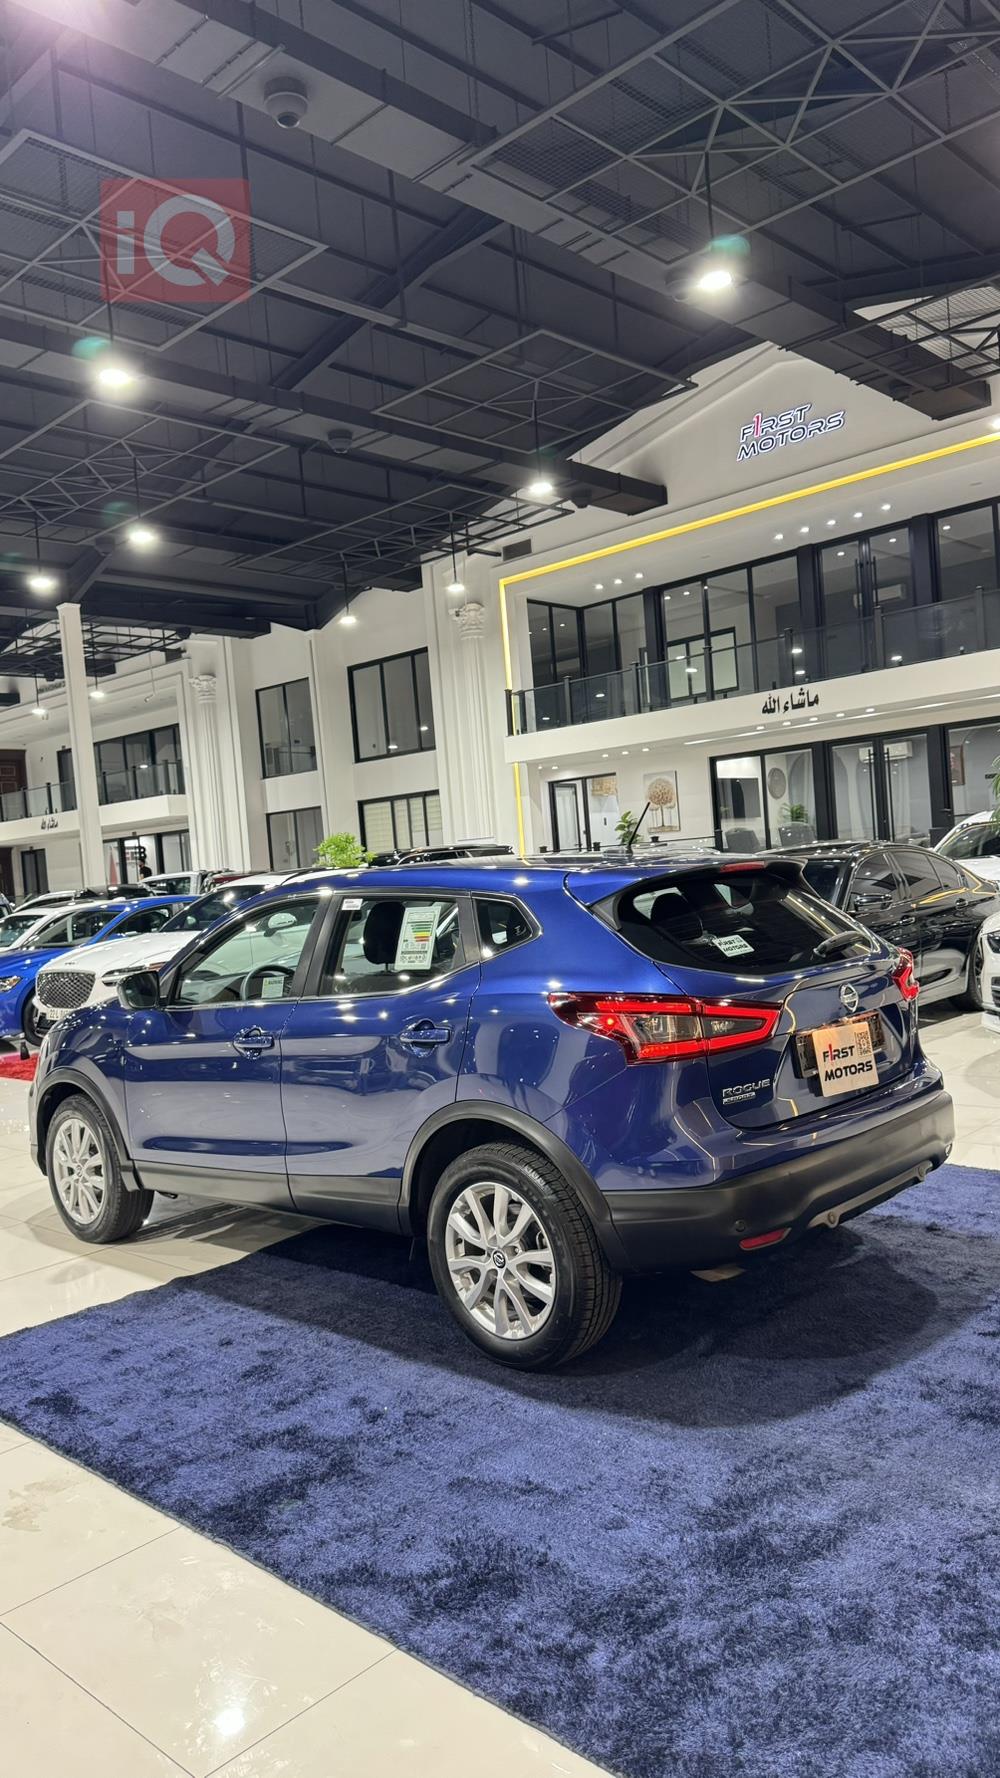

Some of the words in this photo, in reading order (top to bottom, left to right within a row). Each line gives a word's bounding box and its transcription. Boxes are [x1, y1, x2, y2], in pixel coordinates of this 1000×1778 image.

[737, 411, 845, 461] MOTORS
[762, 694, 780, 714] الله
[783, 687, 820, 714] ماشاء
[825, 1061, 873, 1081] MOTORS
[723, 1078, 771, 1097] ROGUE
